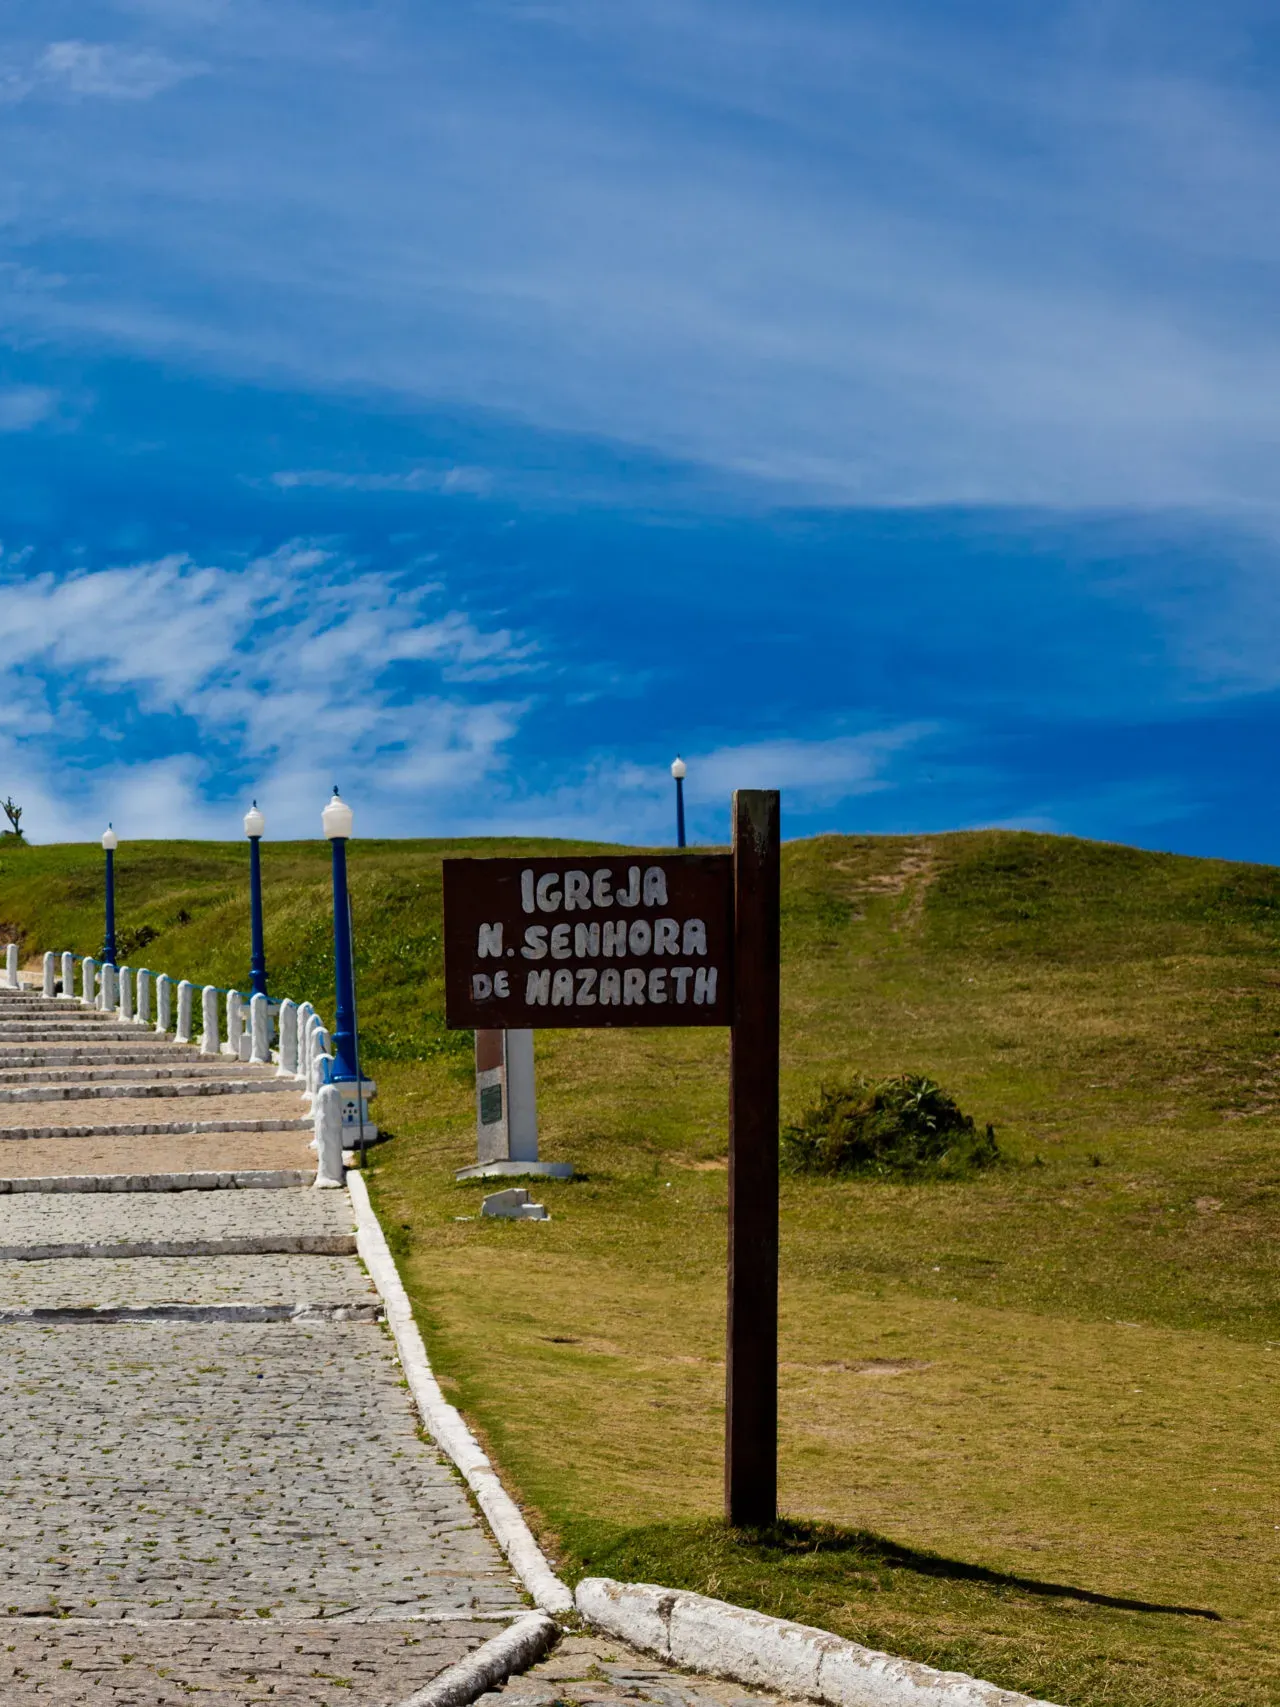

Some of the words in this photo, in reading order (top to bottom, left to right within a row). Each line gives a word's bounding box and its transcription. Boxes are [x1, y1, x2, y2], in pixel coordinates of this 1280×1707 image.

[520, 865, 669, 914] IGREJA
[472, 970, 511, 1000] DE
[524, 966, 719, 1007] NAZARETH
